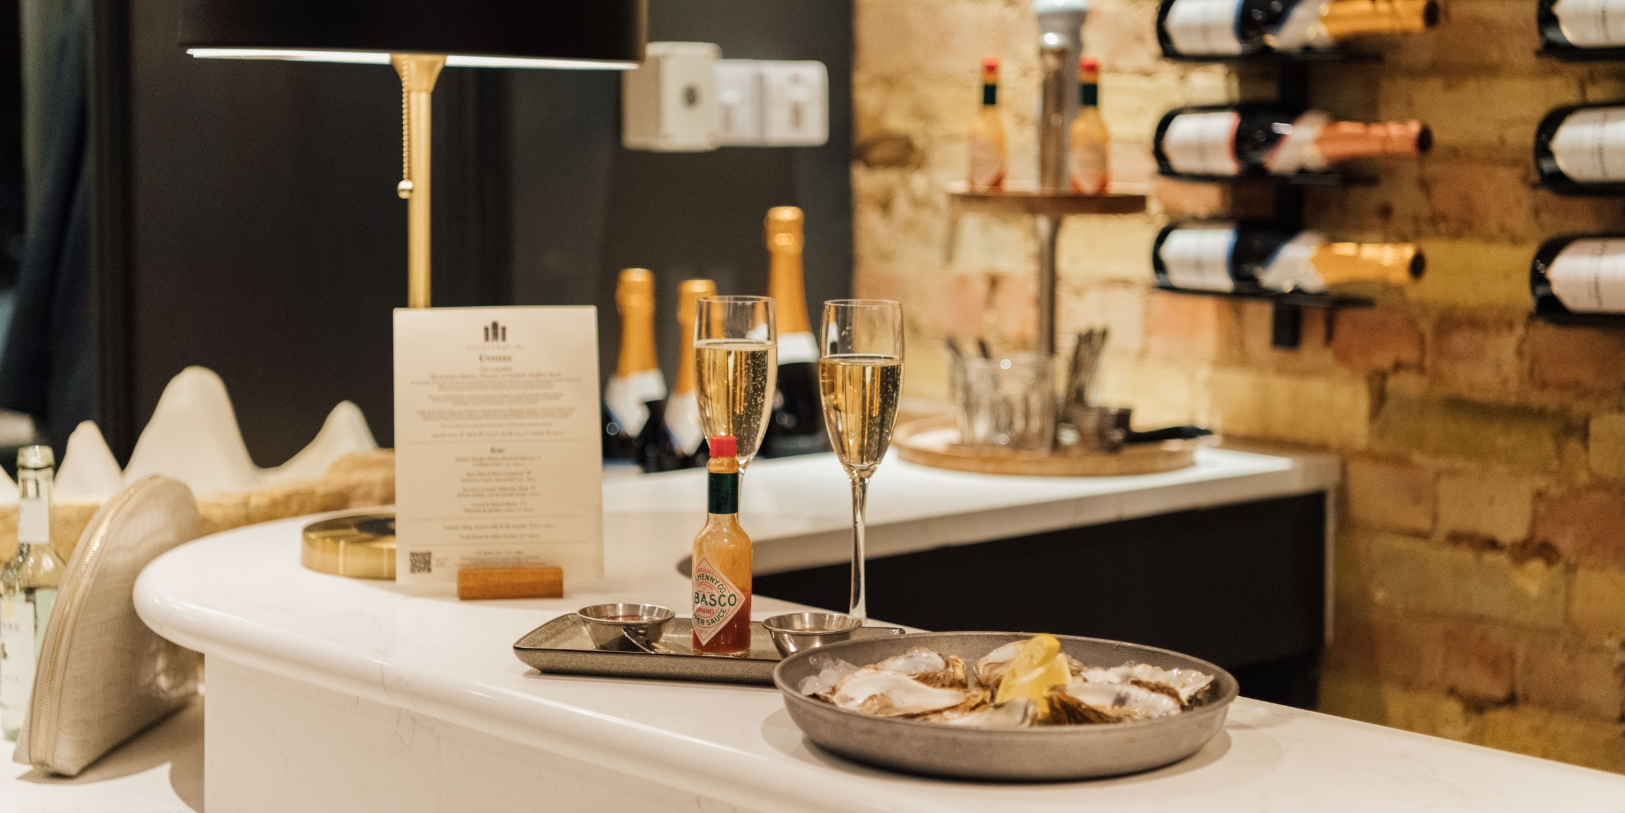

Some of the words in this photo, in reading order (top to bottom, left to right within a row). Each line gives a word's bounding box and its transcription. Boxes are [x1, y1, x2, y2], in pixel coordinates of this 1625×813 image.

[694, 592, 737, 607] BASCO
[696, 607, 715, 615] BRAND
[706, 608, 727, 626] SAUCE
